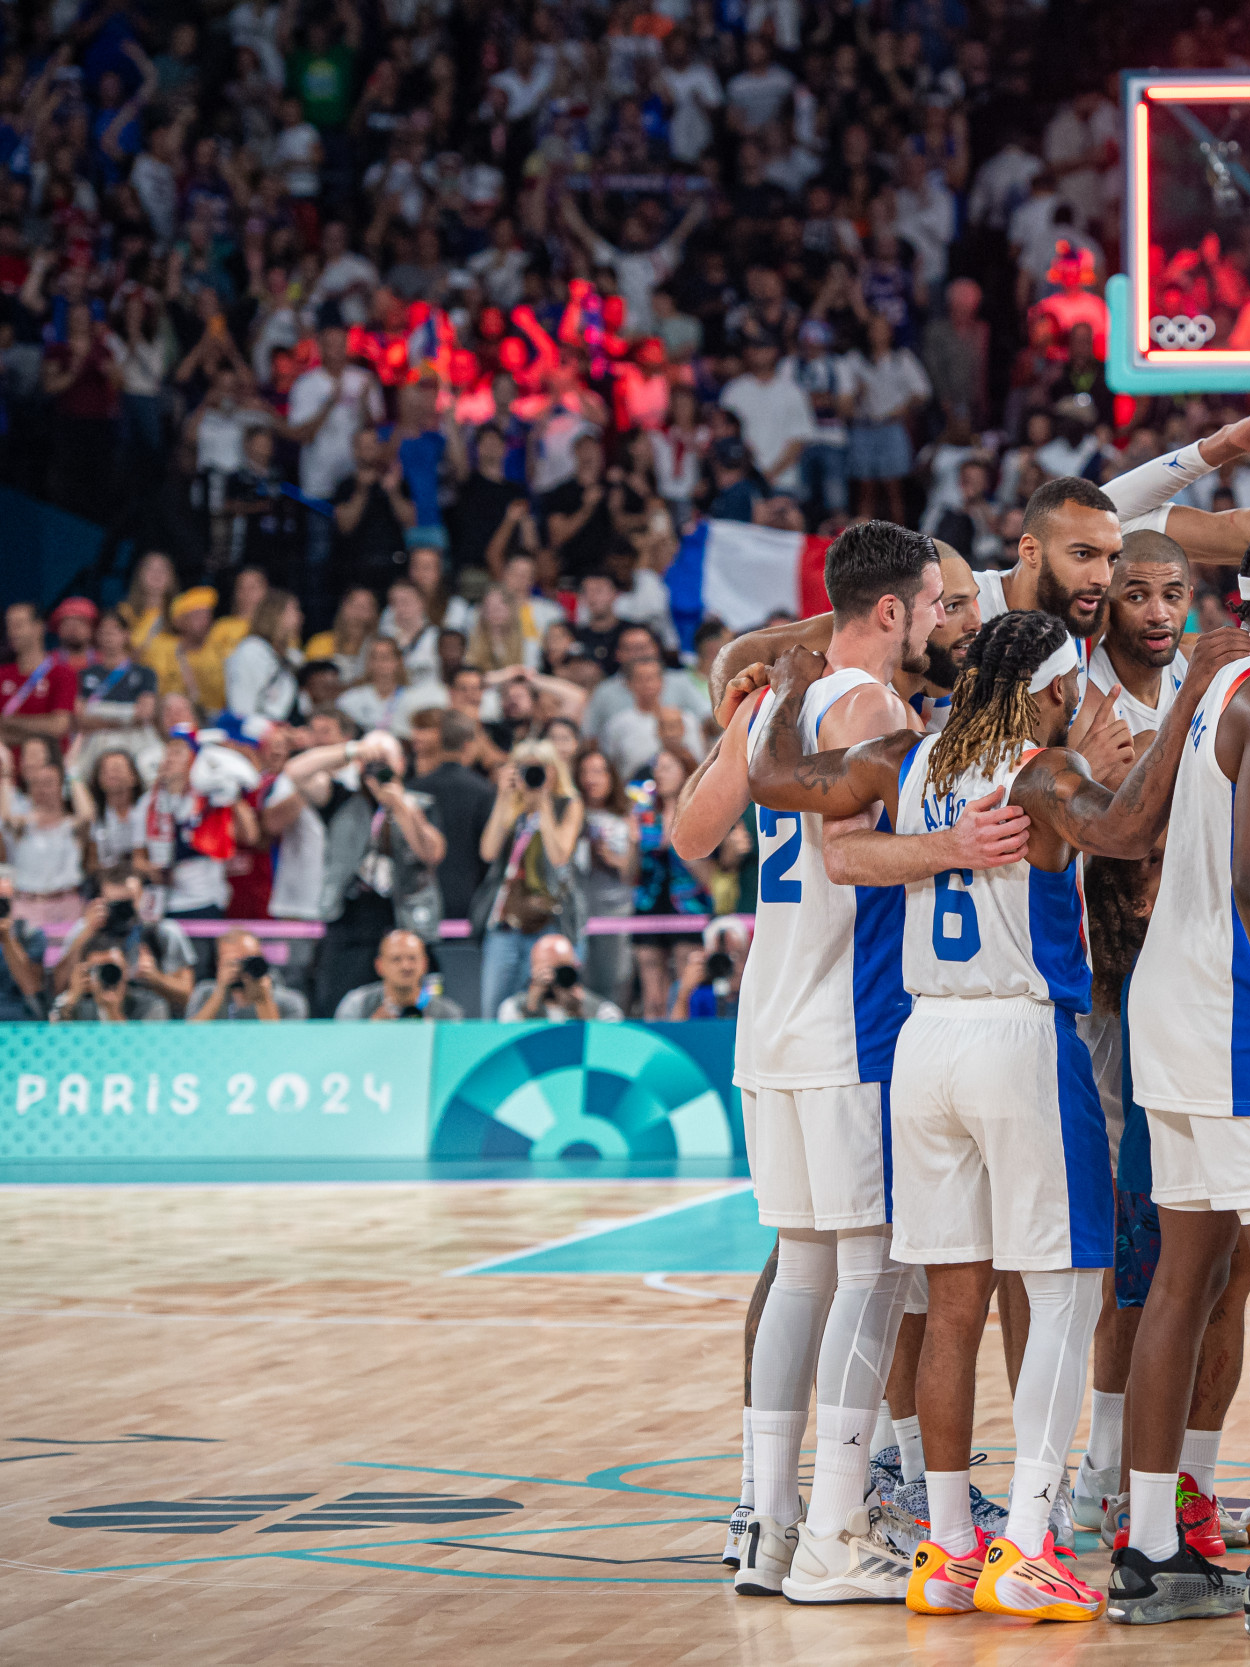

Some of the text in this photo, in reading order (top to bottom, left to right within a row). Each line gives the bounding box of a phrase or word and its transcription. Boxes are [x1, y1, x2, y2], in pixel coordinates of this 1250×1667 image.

[759, 806, 802, 903] 2
[932, 868, 981, 962] 6
[15, 1072, 392, 1115] PARIS 2024
